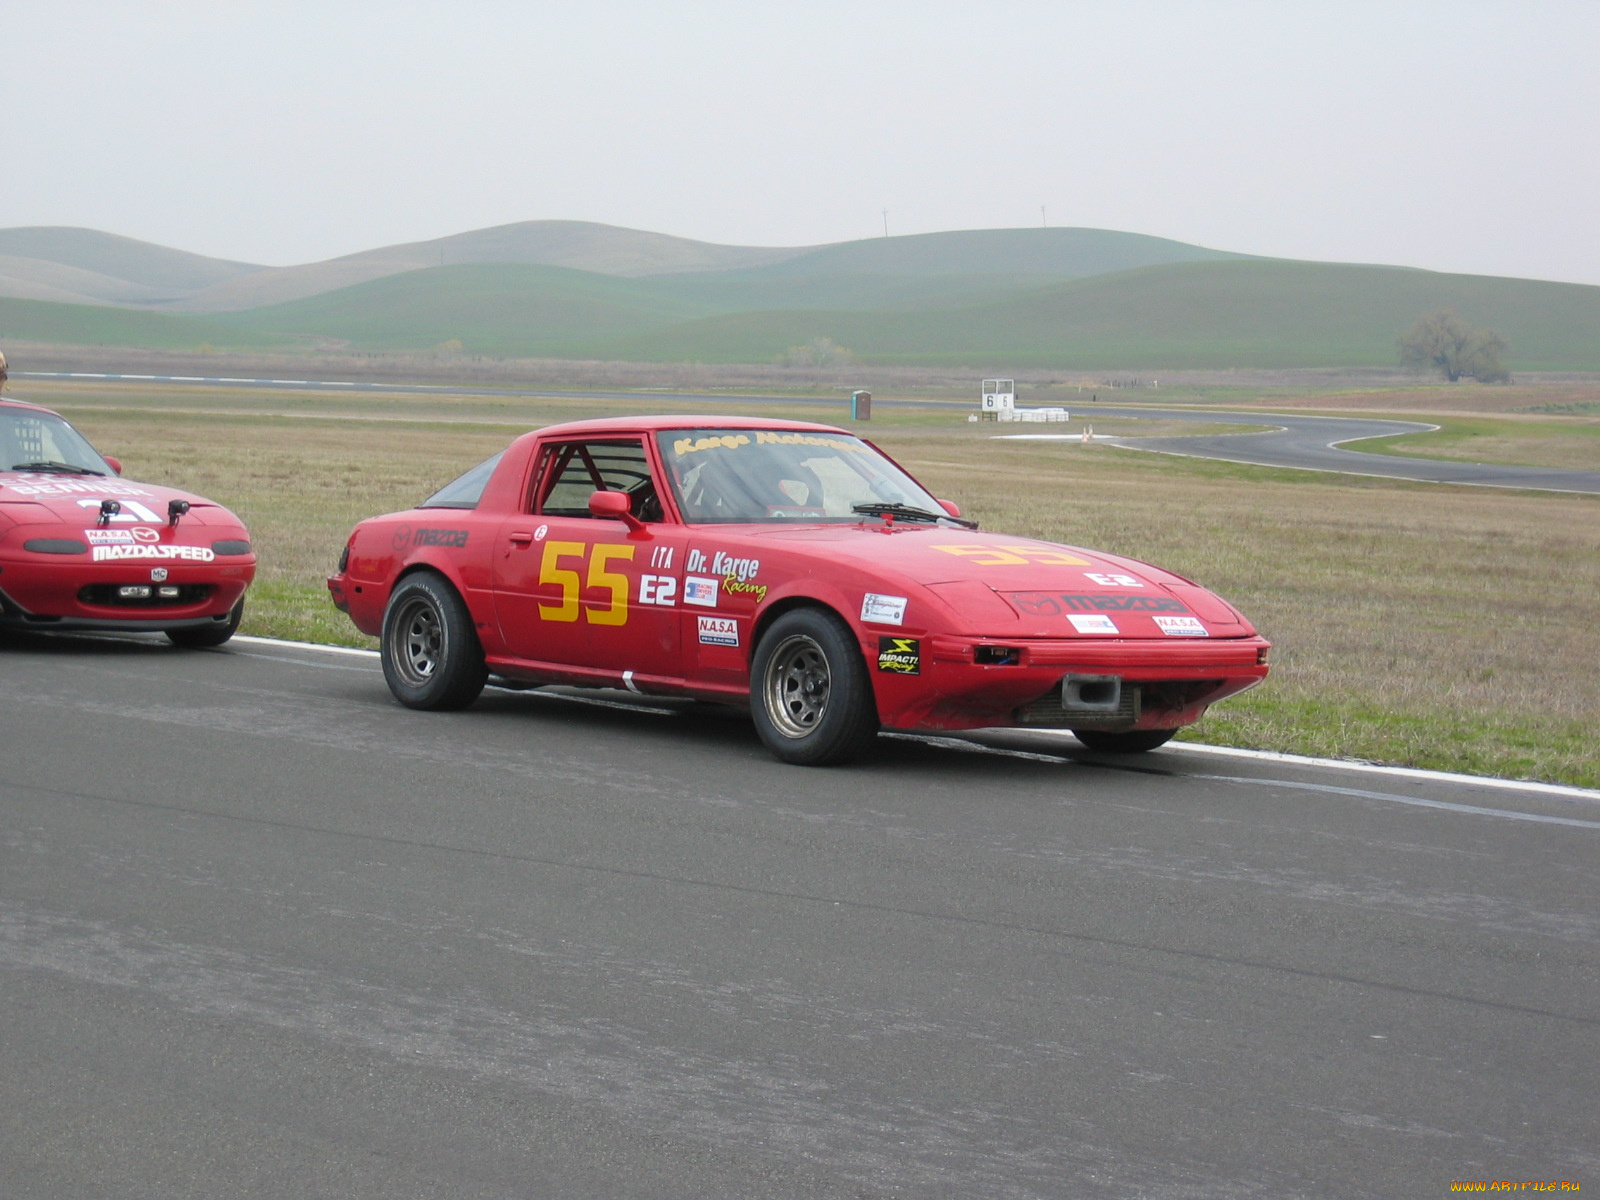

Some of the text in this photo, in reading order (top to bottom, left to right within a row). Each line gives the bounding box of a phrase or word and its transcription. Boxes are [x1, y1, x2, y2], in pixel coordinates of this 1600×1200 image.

[987, 396, 1008, 407] 6 6
[673, 434, 751, 456] Karge
[9, 485, 154, 497] BENNER
[89, 530, 131, 539] N.A.S.A.
[413, 528, 470, 548] mazda
[92, 545, 215, 562] MAZDASPEED
[650, 545, 675, 569] ITA
[930, 544, 1092, 567] 55
[152, 569, 166, 578] MC
[686, 548, 760, 582] Dr. Karge
[537, 540, 637, 627] 55
[721, 571, 768, 604] Racing
[1083, 572, 1144, 589] E2
[638, 574, 678, 607] E2
[1060, 594, 1190, 614] mazda
[700, 619, 736, 634] N.A.S.A.
[1158, 618, 1201, 628] N.A.S.A.
[878, 653, 919, 664] IMPACT!
